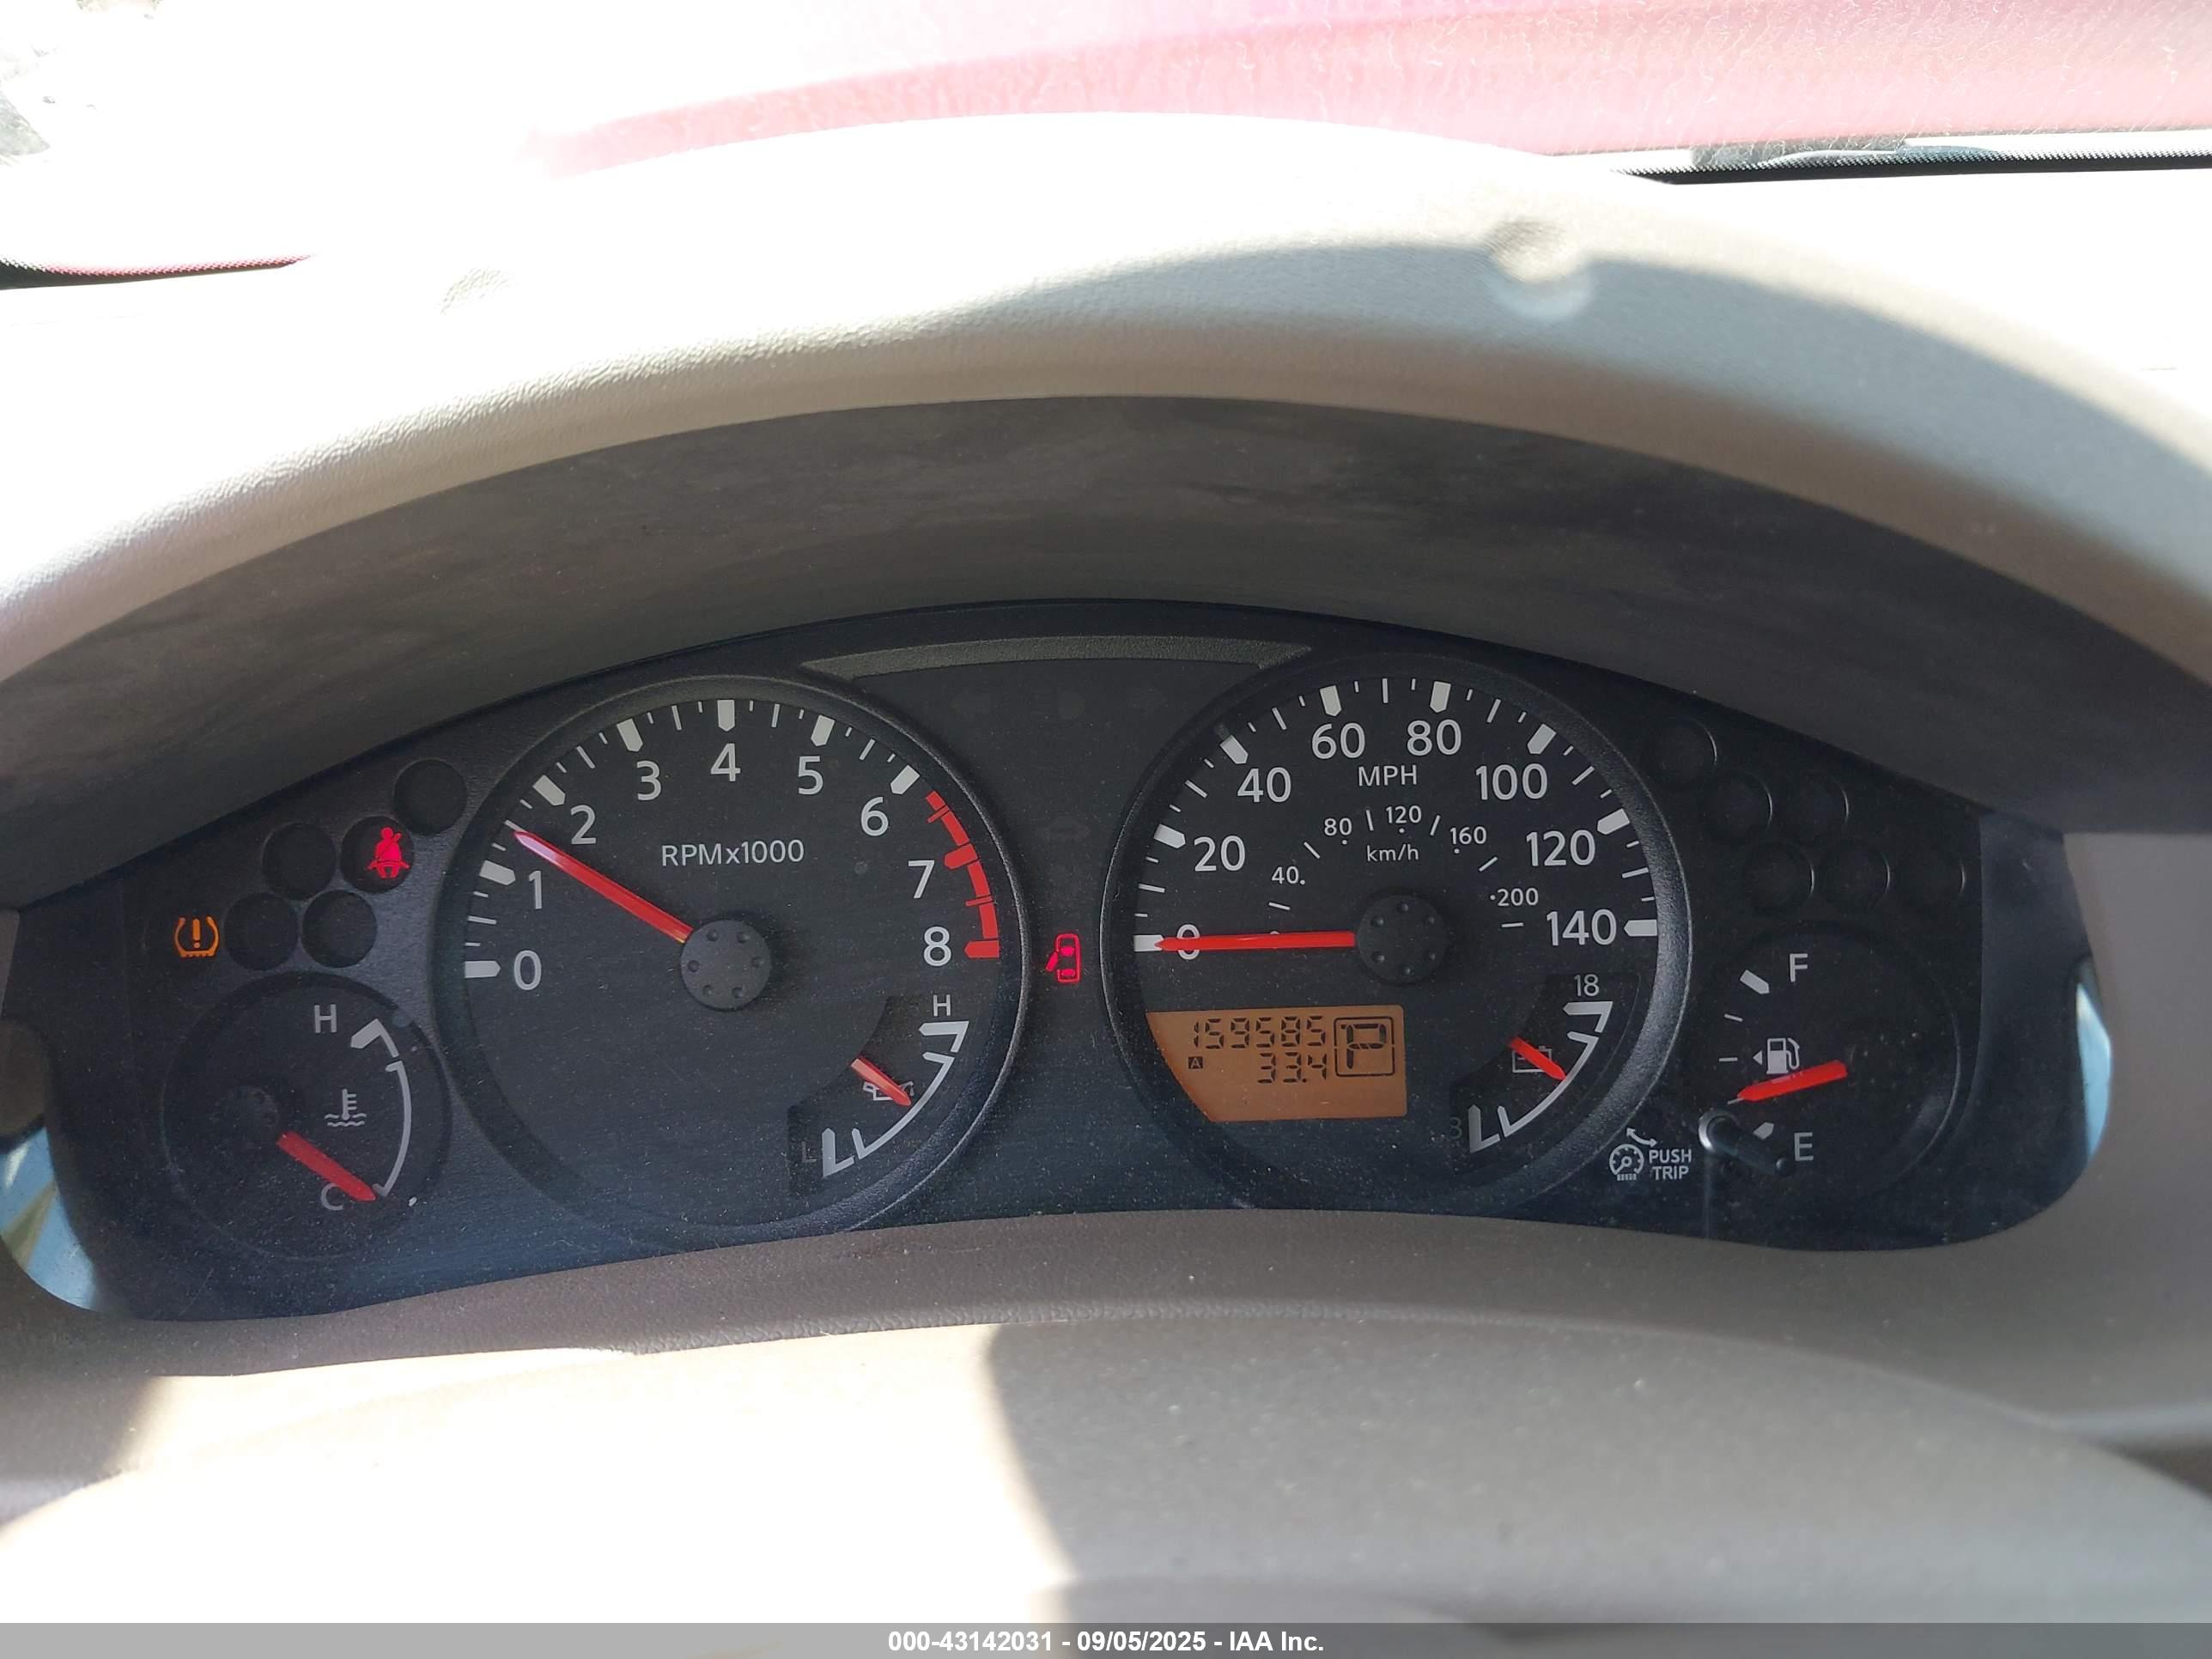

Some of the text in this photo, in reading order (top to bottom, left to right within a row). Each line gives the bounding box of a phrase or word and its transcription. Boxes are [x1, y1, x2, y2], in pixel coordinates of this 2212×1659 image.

[1312, 723, 1364, 759] 60
[1407, 720, 1461, 756] 80
[711, 744, 740, 781] 4
[799, 756, 823, 794] 5
[1358, 765, 1416, 786] MPH
[637, 761, 661, 800] 3
[1237, 768, 1291, 802] 40
[1476, 763, 1547, 799] 100
[571, 805, 596, 844] 2
[861, 797, 888, 836] 6
[1325, 818, 1352, 836] 80
[1387, 805, 1421, 823] 120
[1450, 827, 1486, 844] 160
[1527, 830, 1595, 866] 120
[662, 840, 804, 866] RPMx1000
[1194, 836, 1245, 871] 20
[1367, 844, 1418, 861] km/h
[529, 871, 542, 908] 1
[908, 860, 934, 898] 7
[1272, 866, 1298, 884] 40
[1498, 888, 1538, 906] 200
[1547, 909, 1616, 945] 140
[924, 927, 951, 966] 8
[514, 951, 541, 990] 0
[1790, 953, 1808, 982] F
[1575, 975, 1599, 996] 18
[314, 1005, 337, 1033] H
[933, 994, 951, 1016] H
[1194, 1016, 1326, 1048] 159585
[1341, 1024, 1386, 1068] P
[1258, 1053, 1327, 1083] 33.4
[1650, 1149, 1692, 1164] PUSH
[1795, 1132, 1814, 1161] E
[1652, 1165, 1689, 1180] TRIP
